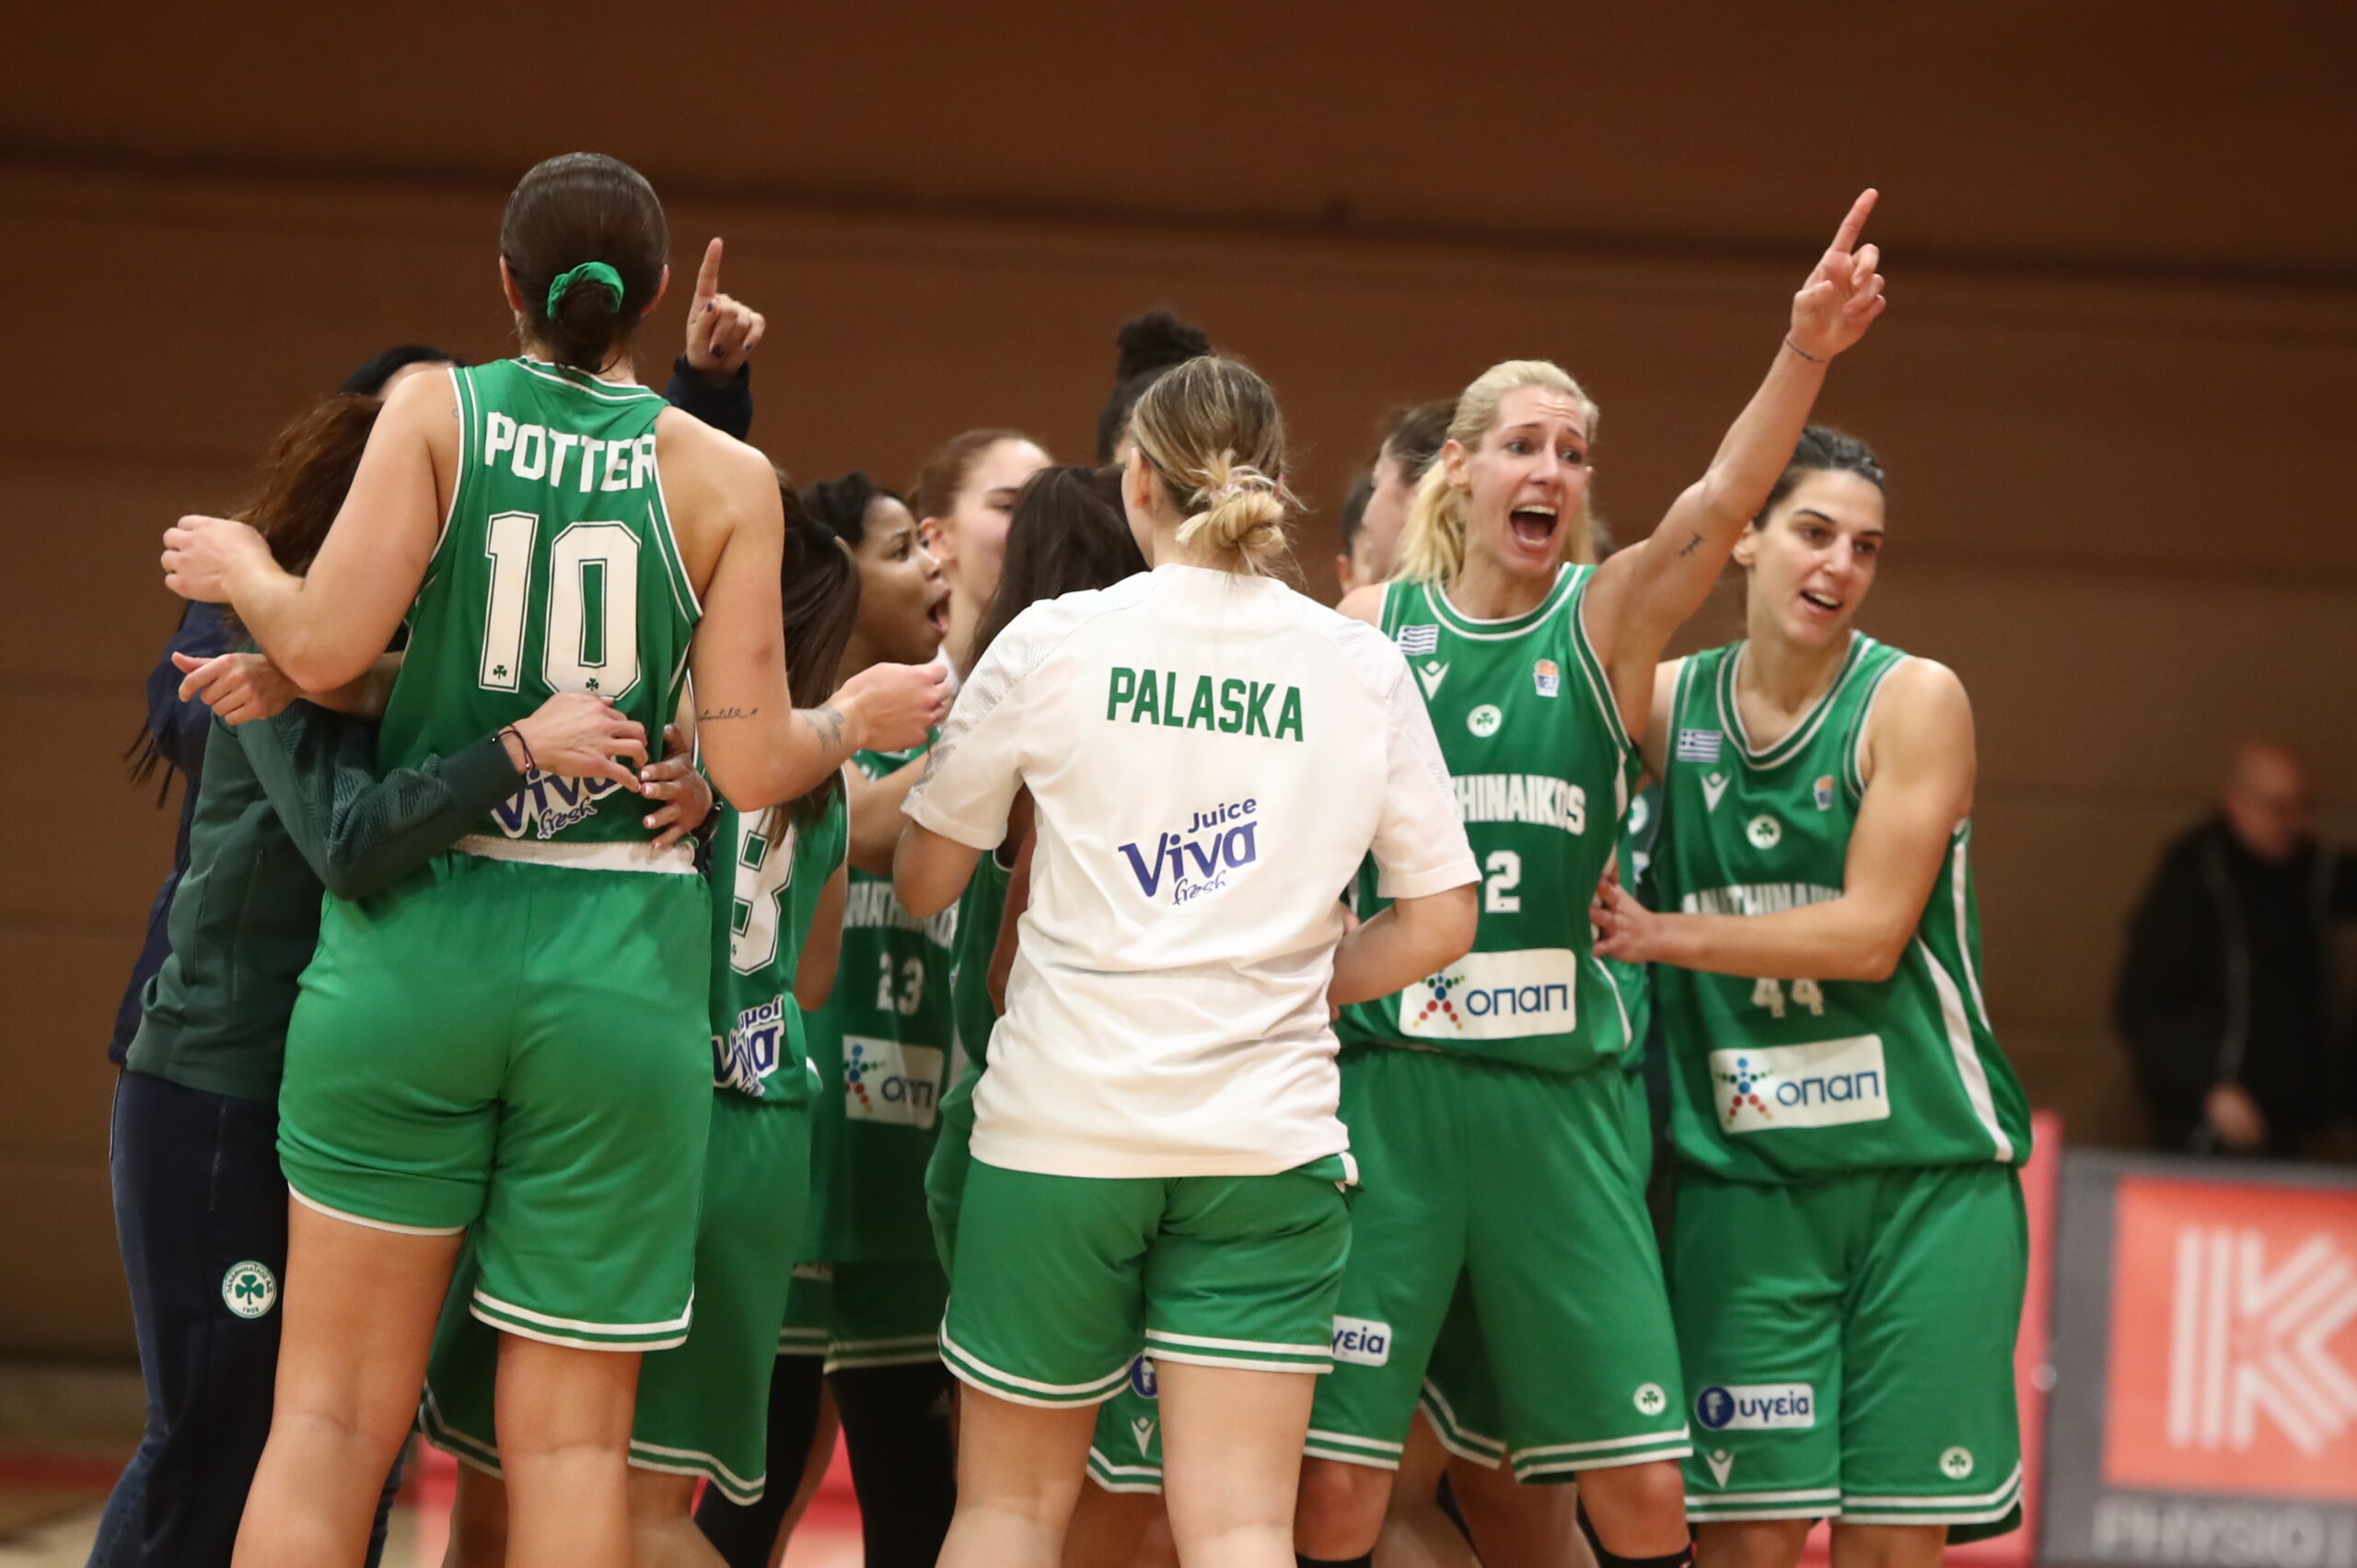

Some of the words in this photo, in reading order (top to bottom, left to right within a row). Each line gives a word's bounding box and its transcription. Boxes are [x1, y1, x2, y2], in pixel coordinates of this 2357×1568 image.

[484, 412, 656, 494] POTTER
[478, 510, 643, 702] 10
[1106, 666, 1304, 742] PALASKA
[1187, 798, 1257, 834] Juice
[1450, 773, 1586, 836] HINAIKOS
[1117, 820, 1258, 898] Viva
[1484, 849, 1521, 913] 2
[1332, 1326, 1385, 1354] γεία
